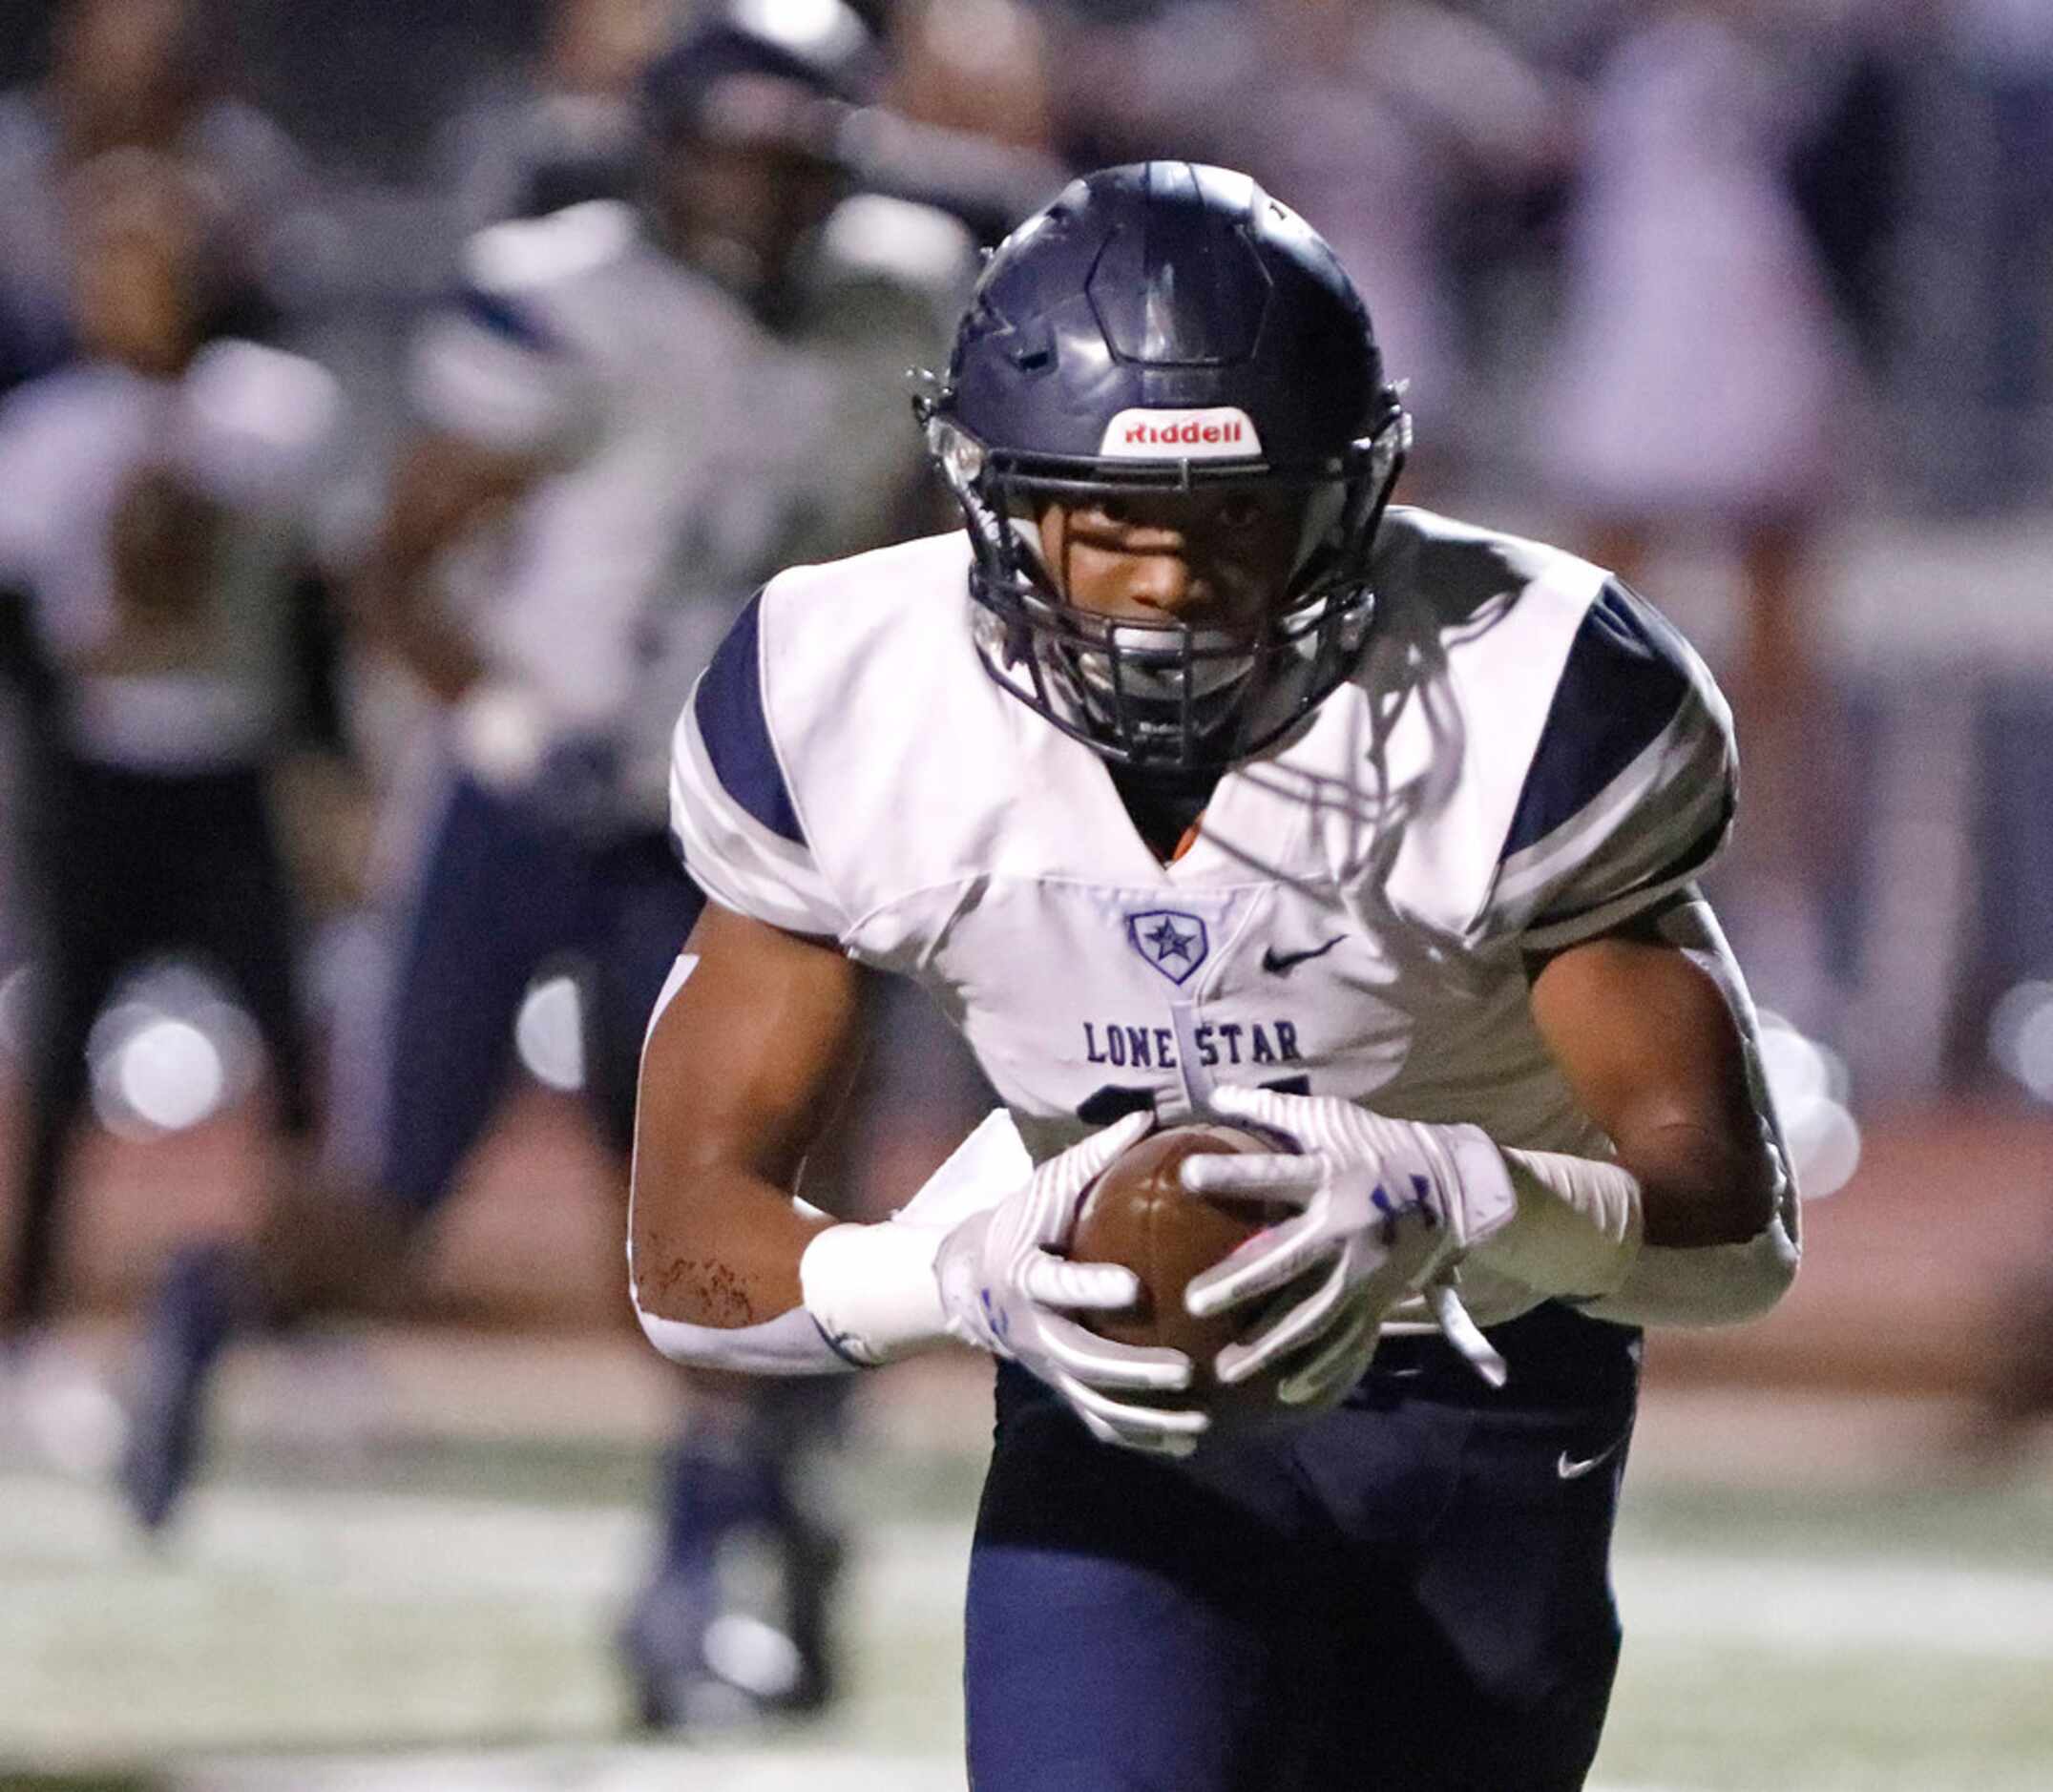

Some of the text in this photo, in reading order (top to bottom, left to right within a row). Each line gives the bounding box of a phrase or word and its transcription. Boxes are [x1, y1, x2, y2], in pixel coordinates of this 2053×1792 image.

[1124, 421, 1242, 444] Riddell
[1083, 1020, 1302, 1069] LONE STAR
